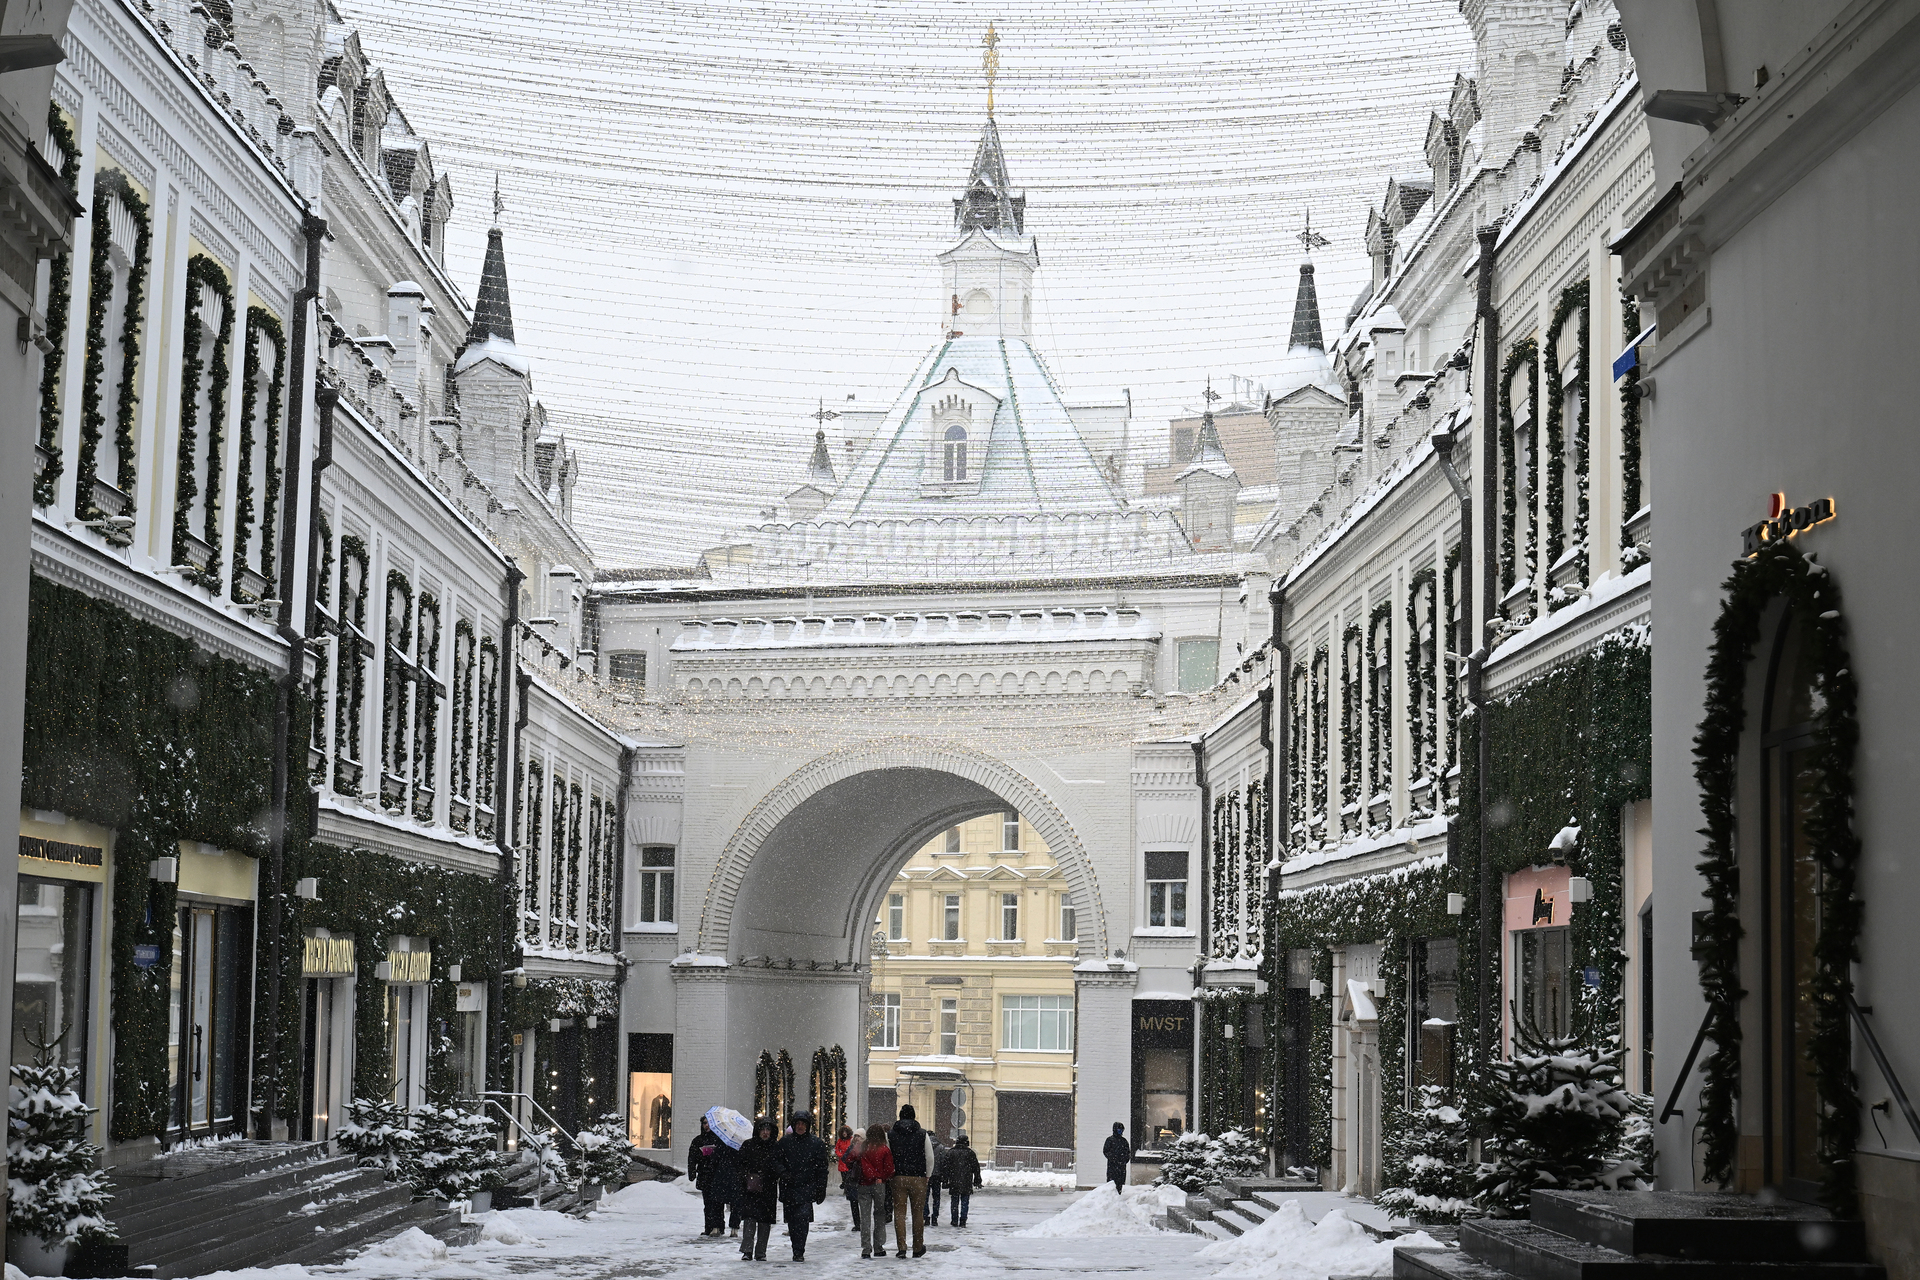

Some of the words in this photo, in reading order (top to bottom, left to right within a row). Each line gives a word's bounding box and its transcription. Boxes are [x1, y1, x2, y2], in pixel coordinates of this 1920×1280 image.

[1741, 493, 1835, 557] Kiton
[47, 839, 80, 864] CONCEPT
[80, 846, 102, 866] STORE
[1140, 1017, 1184, 1030] MVST
